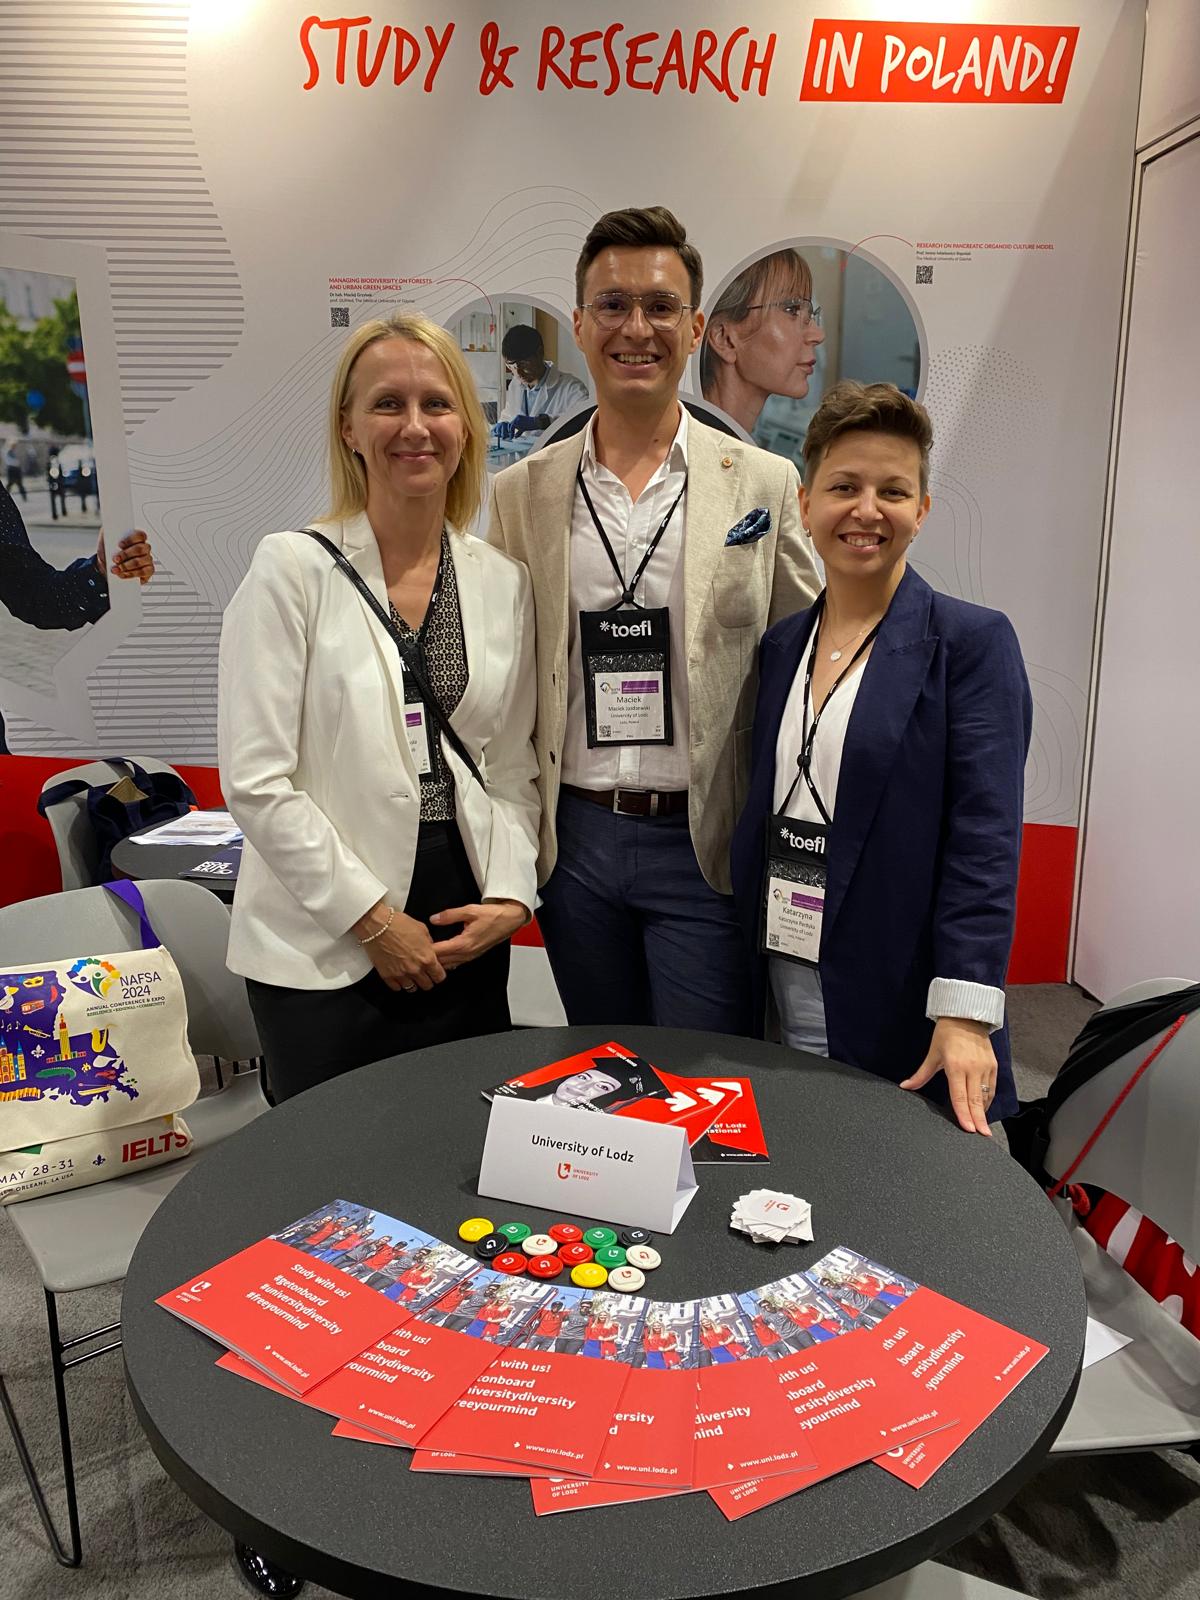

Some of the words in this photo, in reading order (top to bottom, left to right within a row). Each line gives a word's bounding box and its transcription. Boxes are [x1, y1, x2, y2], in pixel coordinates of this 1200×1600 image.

[302, 14, 455, 92] STUDY
[477, 21, 519, 96] &
[536, 25, 777, 102] RESEARCH
[813, 33, 863, 90] IN
[881, 33, 1067, 96] POLAND!
[611, 620, 652, 637] toefl
[789, 833, 825, 854] toefl
[783, 906, 813, 921] Katarzyna
[119, 971, 162, 986] NAFSA
[122, 985, 151, 999] 2024
[86, 1004, 109, 1012] ANNUAL
[109, 999, 145, 1009] CONFERENCE
[122, 1131, 188, 1163] IELTS
[531, 1134, 589, 1156] University
[591, 1146, 604, 1157] of
[607, 1148, 635, 1163] Lodz
[0, 1169, 26, 1184] MAY
[33, 1158, 74, 1177] 28-31
[61, 1172, 74, 1180] USA
[573, 1168, 599, 1177] UNIVERSITY
[291, 1263, 317, 1280] Study
[314, 1276, 335, 1291] with
[334, 1287, 351, 1299] us!
[273, 1274, 329, 1307] #getonboard
[246, 1291, 310, 1330] #freeyourmind
[260, 1283, 343, 1335] #universitydiversity
[412, 1335, 432, 1345] us!
[894, 1326, 909, 1341] us!
[376, 1340, 411, 1357] board
[911, 1328, 966, 1379] ersitydiversity
[272, 1350, 310, 1378] www.uni.lodz.pl
[500, 1360, 529, 1370] with
[531, 1364, 552, 1373] us!
[800, 1361, 819, 1375] us!
[1002, 1345, 1031, 1376] www.uni.lodz.pl
[794, 1376, 877, 1415] ersitydiversity
[368, 1408, 416, 1430] www.uni.lodz.pl
[614, 1411, 655, 1425] ersity
[891, 1410, 939, 1433] www.uni.lodz.pl
[525, 1444, 584, 1460] www.uni.lodz.pl
[740, 1450, 798, 1468] www.uni.lodz.pl
[902, 1442, 925, 1465] UNIVERSITY
[617, 1464, 678, 1475] www.uni.lodz.pl
[551, 1481, 590, 1492] UNIVERSITY
[561, 1488, 578, 1497] LODZ
